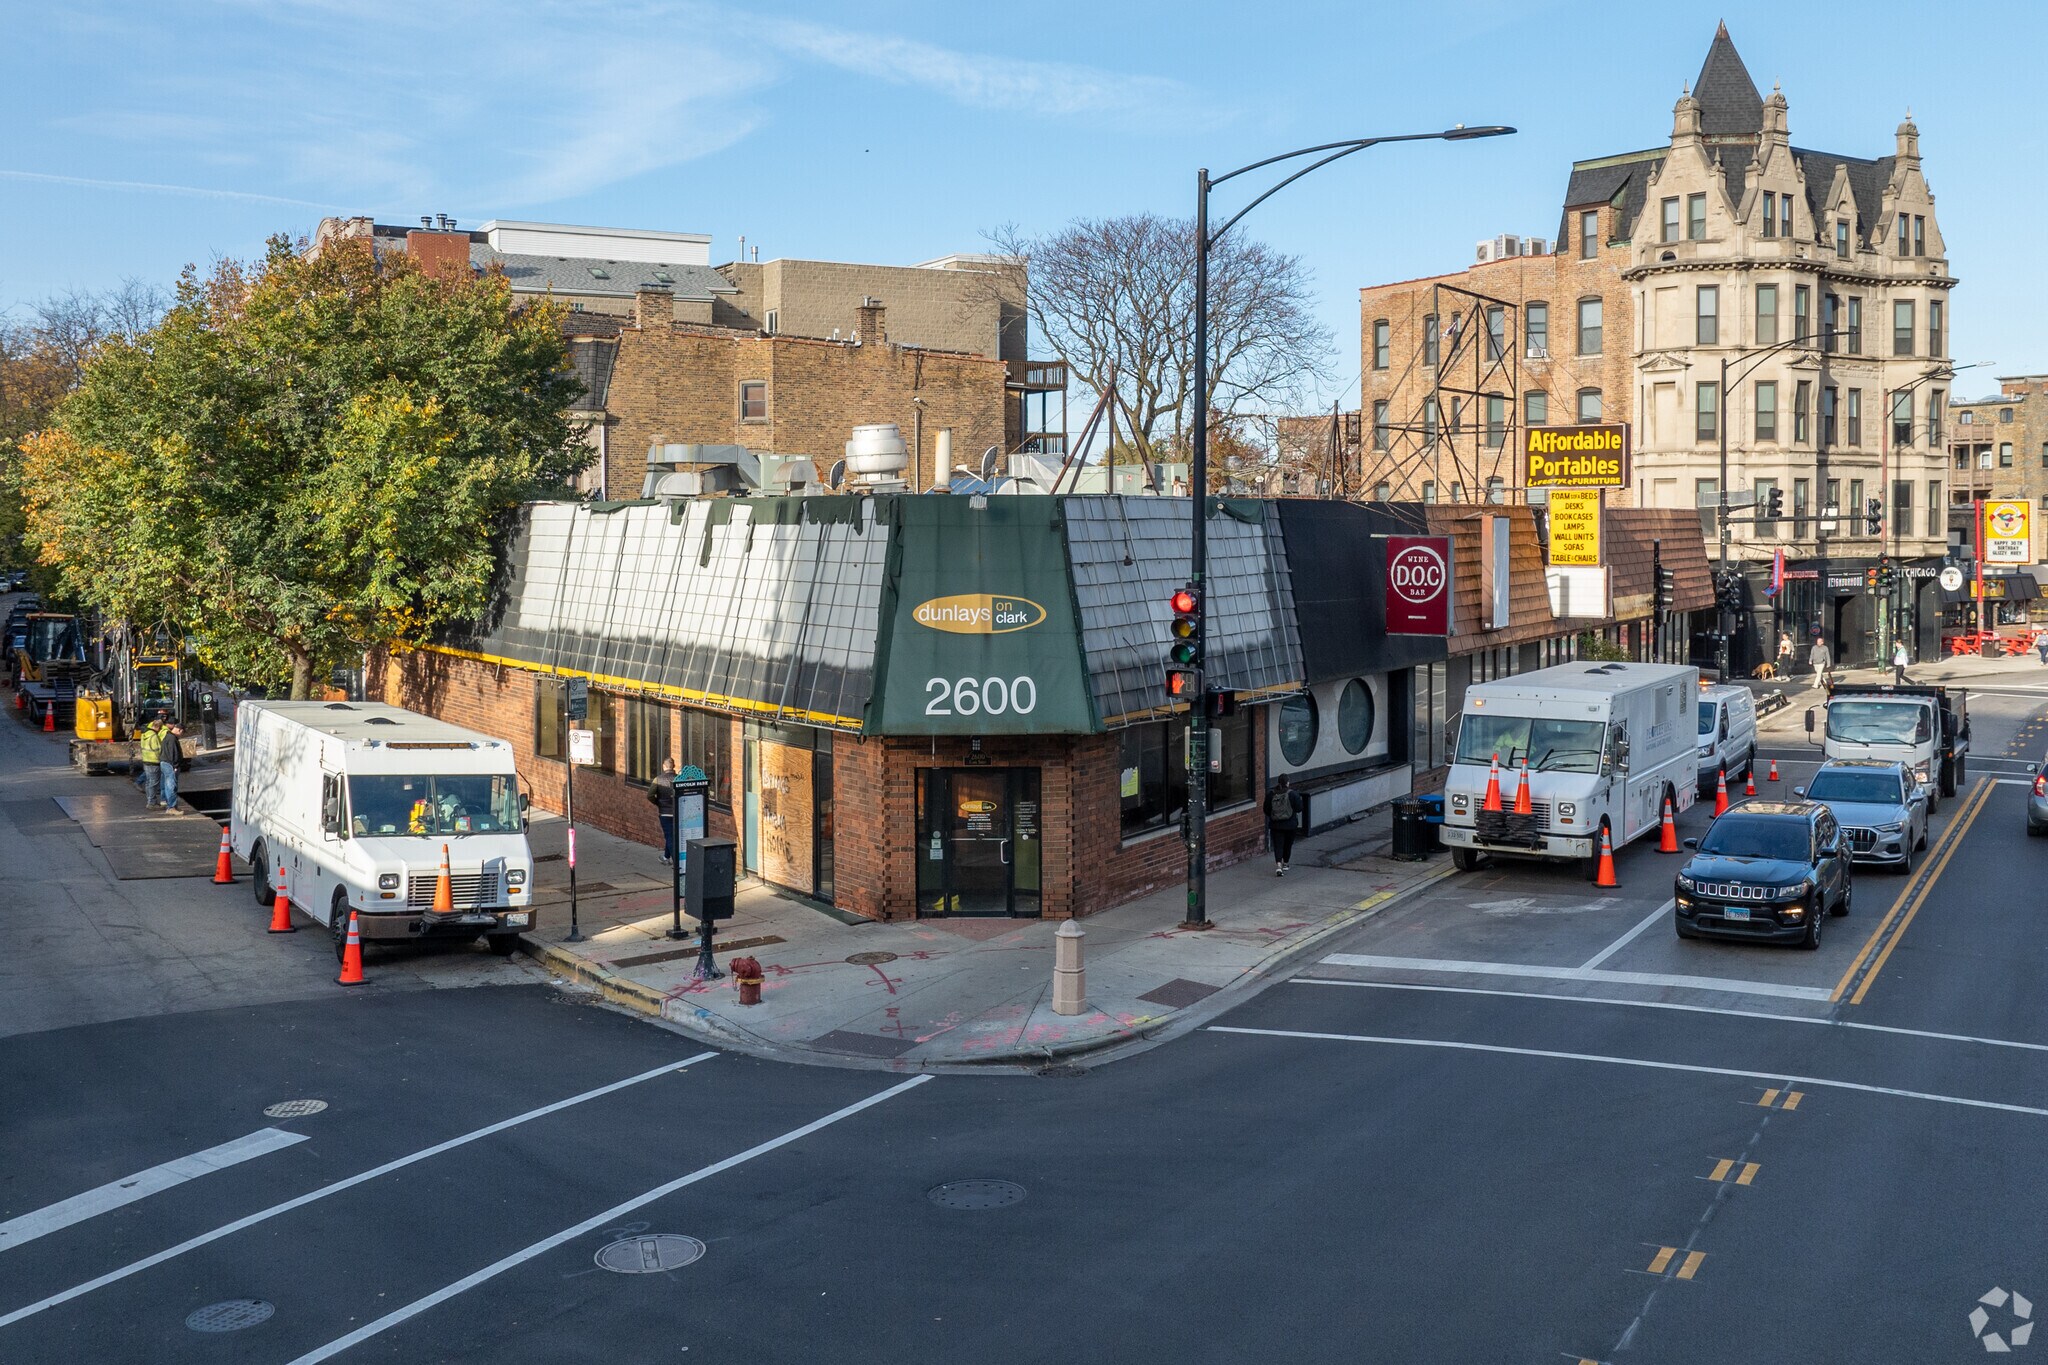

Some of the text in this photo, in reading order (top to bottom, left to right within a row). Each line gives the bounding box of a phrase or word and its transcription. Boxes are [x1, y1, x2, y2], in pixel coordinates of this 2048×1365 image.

[1528, 430, 1622, 453] Affordable
[1529, 455, 1619, 477] Portables
[1572, 477, 1621, 485] FURNITURE
[1551, 492, 1570, 500] FOAM
[1580, 492, 1598, 500] BEDS
[1555, 513, 1593, 521] BOOKCASES
[1563, 523, 1585, 531] LAMPS
[1554, 533, 1594, 541] WALL UNITS
[1563, 543, 1585, 551] SOFAS
[1574, 554, 1597, 562] CHAIRS
[1396, 565, 1440, 587] D.O.C
[1905, 567, 1936, 578] CHICAGO
[995, 601, 1013, 612] on
[918, 604, 991, 626] dunlays
[995, 611, 1028, 624] clark
[925, 676, 1037, 716] 2600
